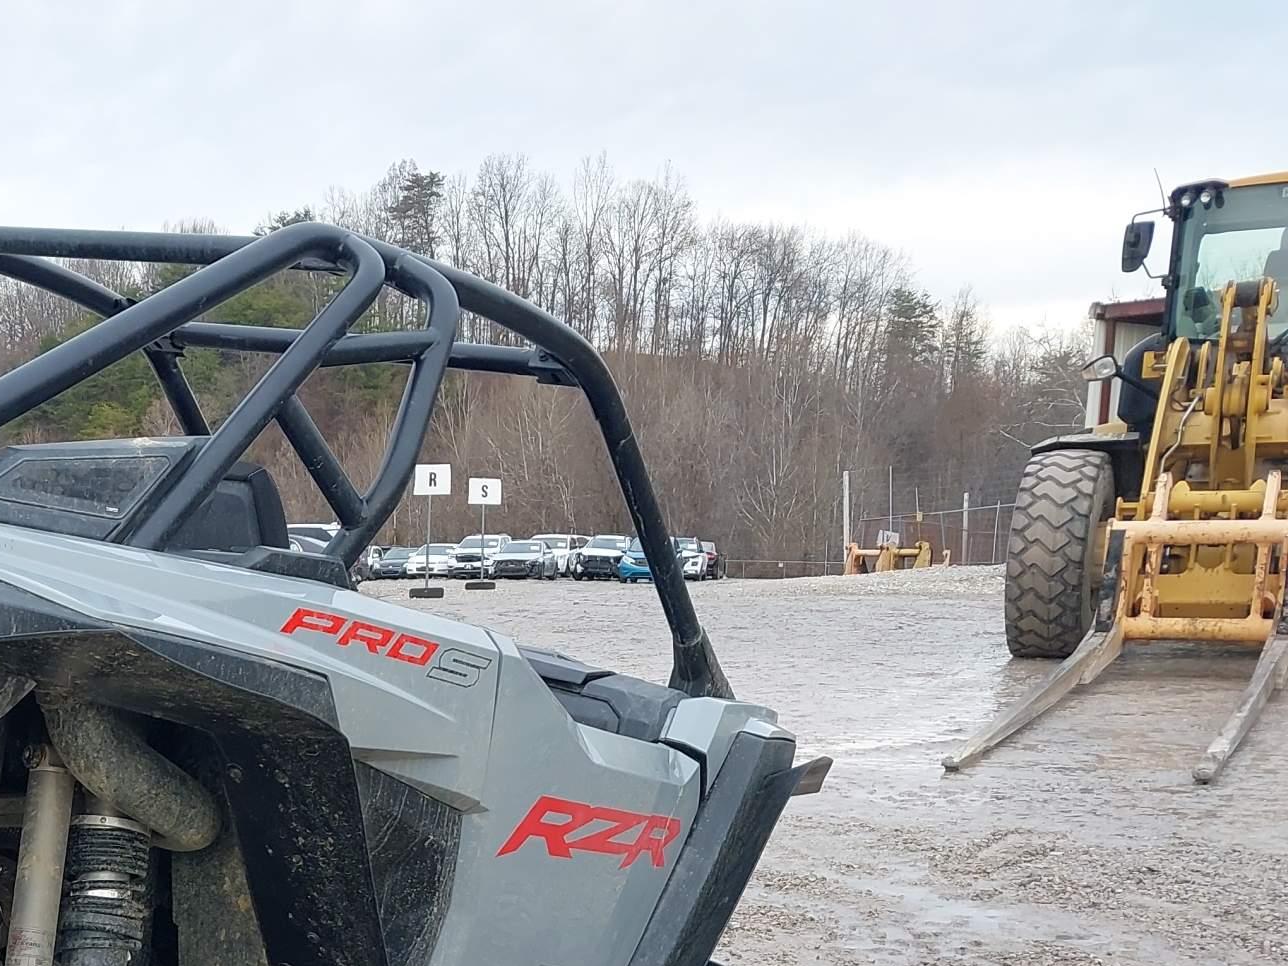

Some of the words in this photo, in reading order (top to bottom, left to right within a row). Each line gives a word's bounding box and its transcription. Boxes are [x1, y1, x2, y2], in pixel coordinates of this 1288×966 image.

[428, 471, 438, 488] R
[480, 484, 489, 498] S
[279, 607, 440, 668] PRO
[495, 794, 681, 870] RZR
